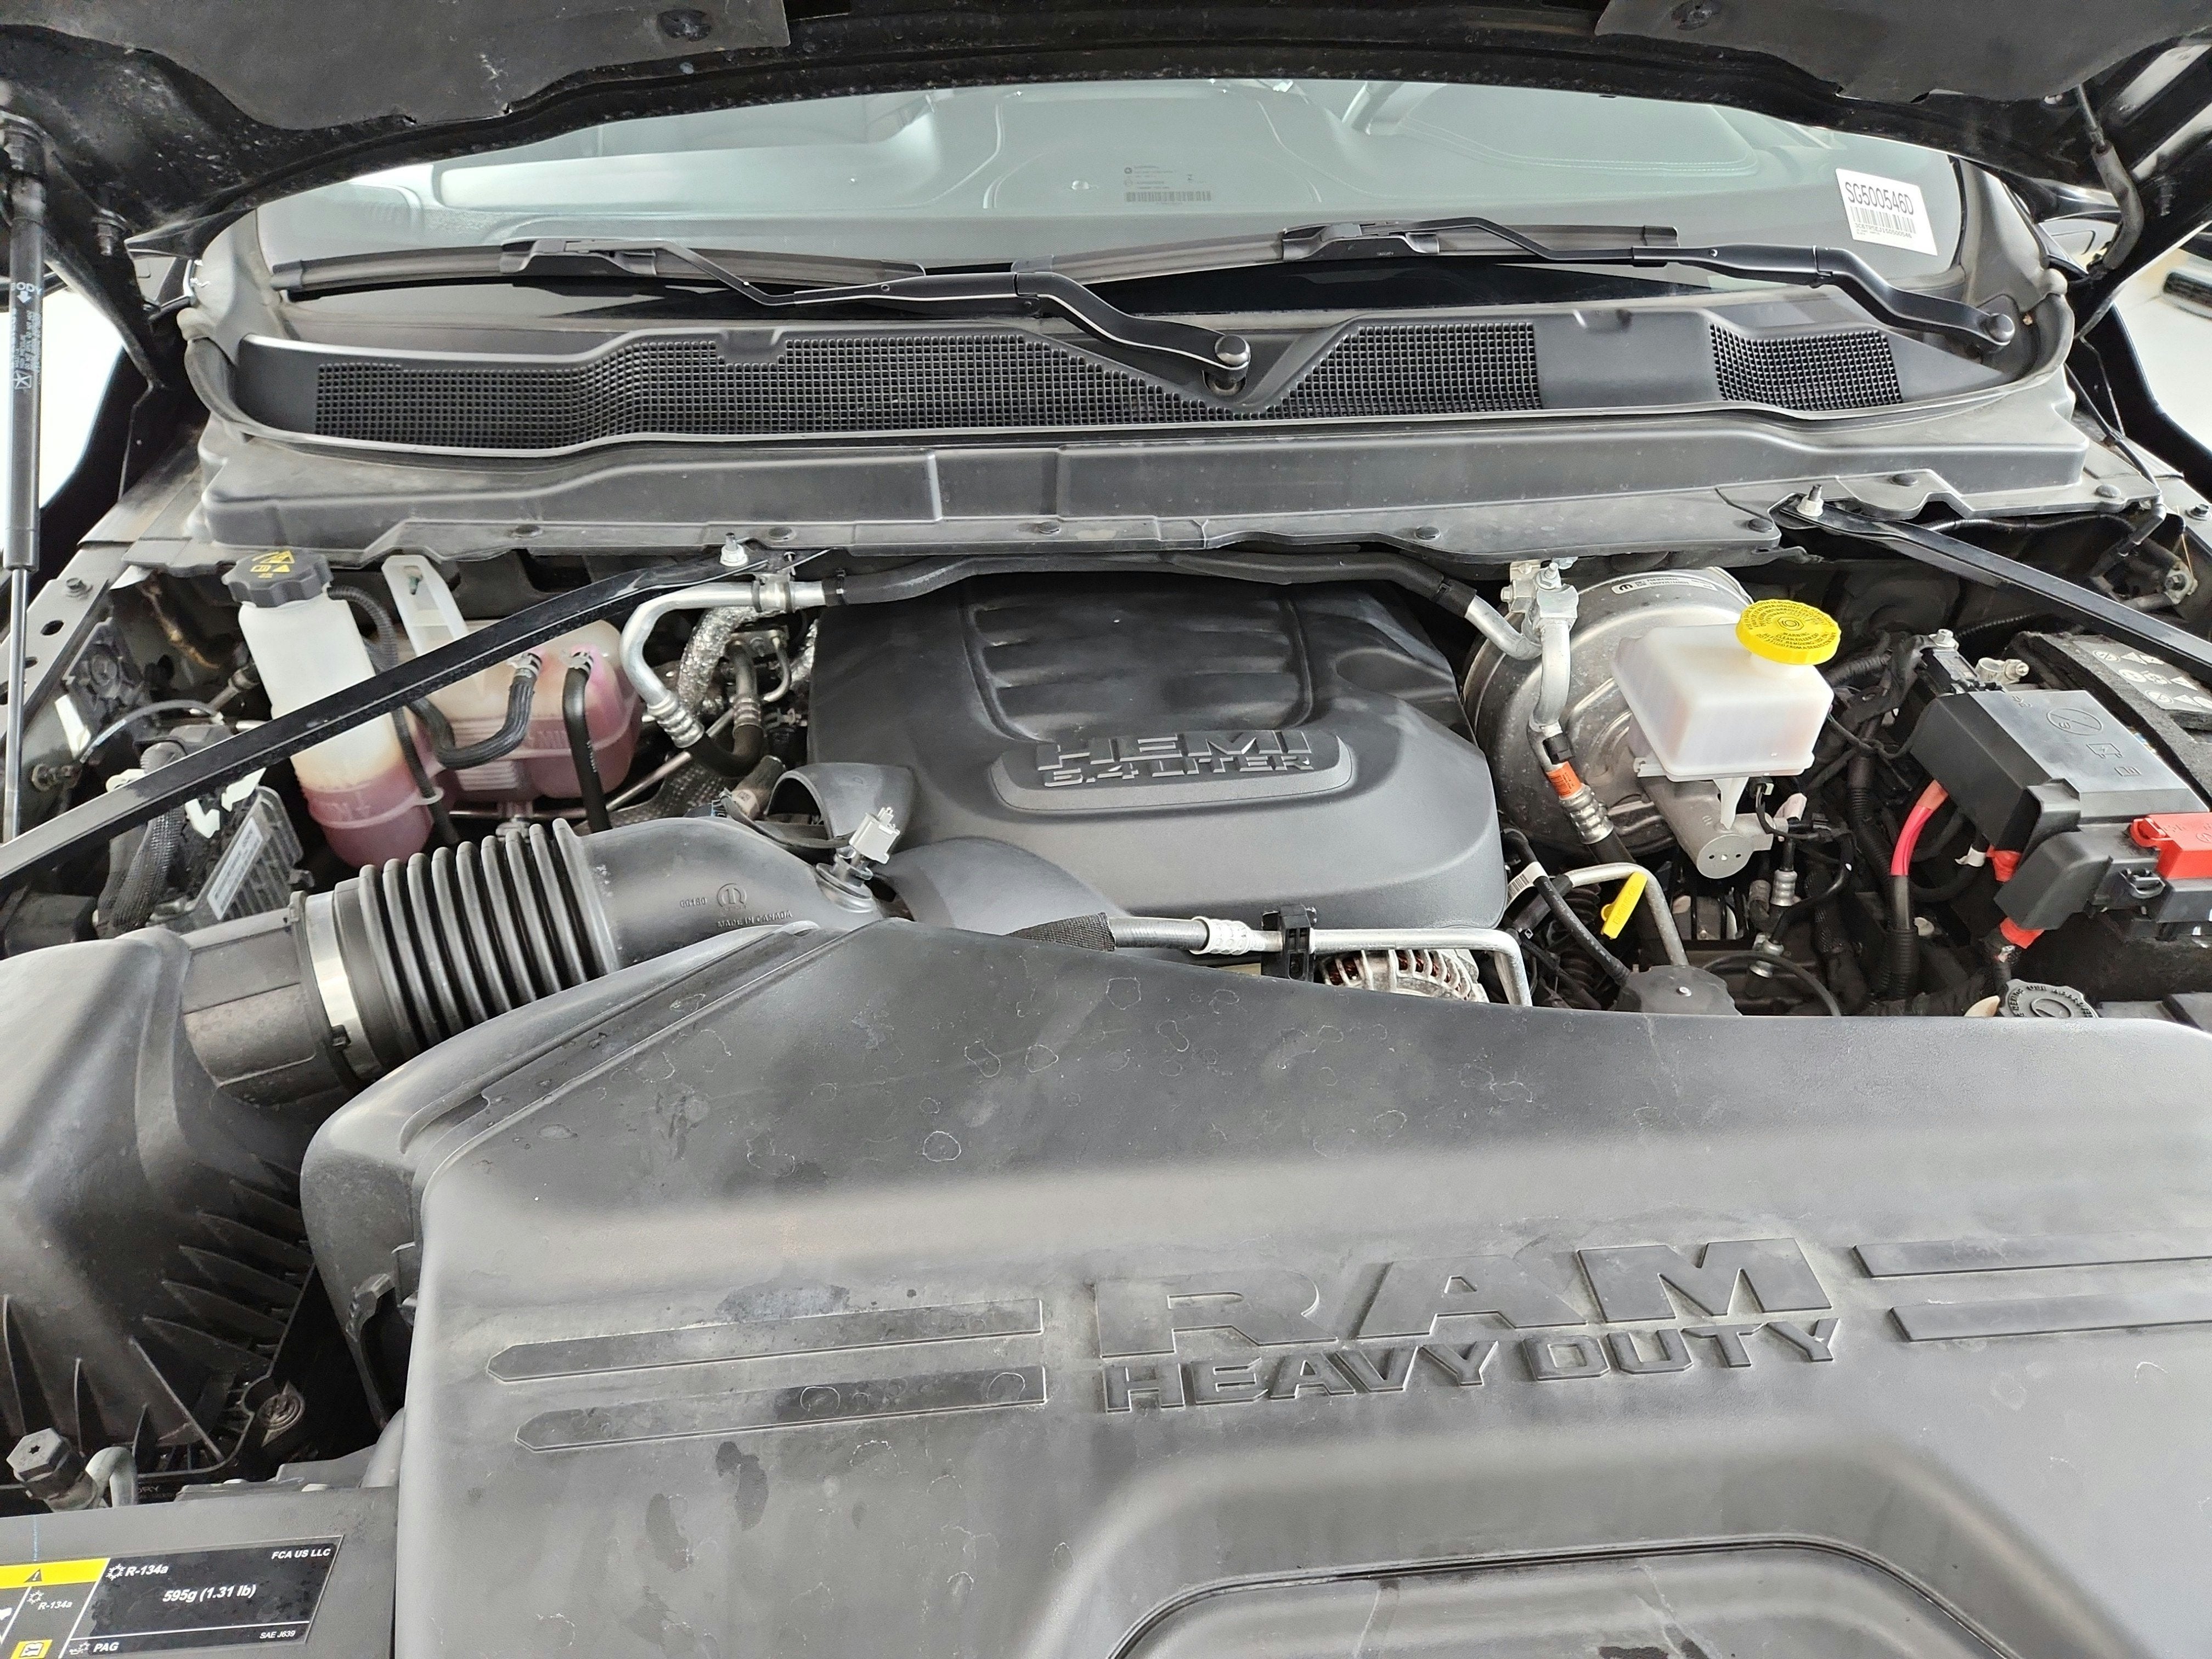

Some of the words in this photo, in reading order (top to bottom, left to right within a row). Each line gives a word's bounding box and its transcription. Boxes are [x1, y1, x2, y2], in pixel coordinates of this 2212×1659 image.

[1845, 182, 1914, 215] SG500546D
[1763, 633, 1783, 642] BEFORE
[1769, 639, 1785, 647] FLUID
[1037, 730, 1312, 771] HEMI
[1152, 754, 1314, 778] LITER
[716, 919, 743, 928] MADE
[757, 910, 792, 923] CANADA
[1096, 1238, 1832, 1358] RAM
[1104, 1340, 1498, 1414] HEAVY
[1523, 1318, 1840, 1381] DUTY
[272, 1550, 292, 1560] FCA
[295, 1549, 309, 1558] US
[311, 1548, 331, 1557] LLC
[125, 1564, 169, 1577] R-134a
[162, 1589, 198, 1602] 595g
[200, 1586, 234, 1602] (1.31
[237, 1584, 257, 1598] lb)
[38, 1600, 72, 1610] R-134a
[277, 1630, 296, 1638] J639
[93, 1642, 119, 1652] PAG
